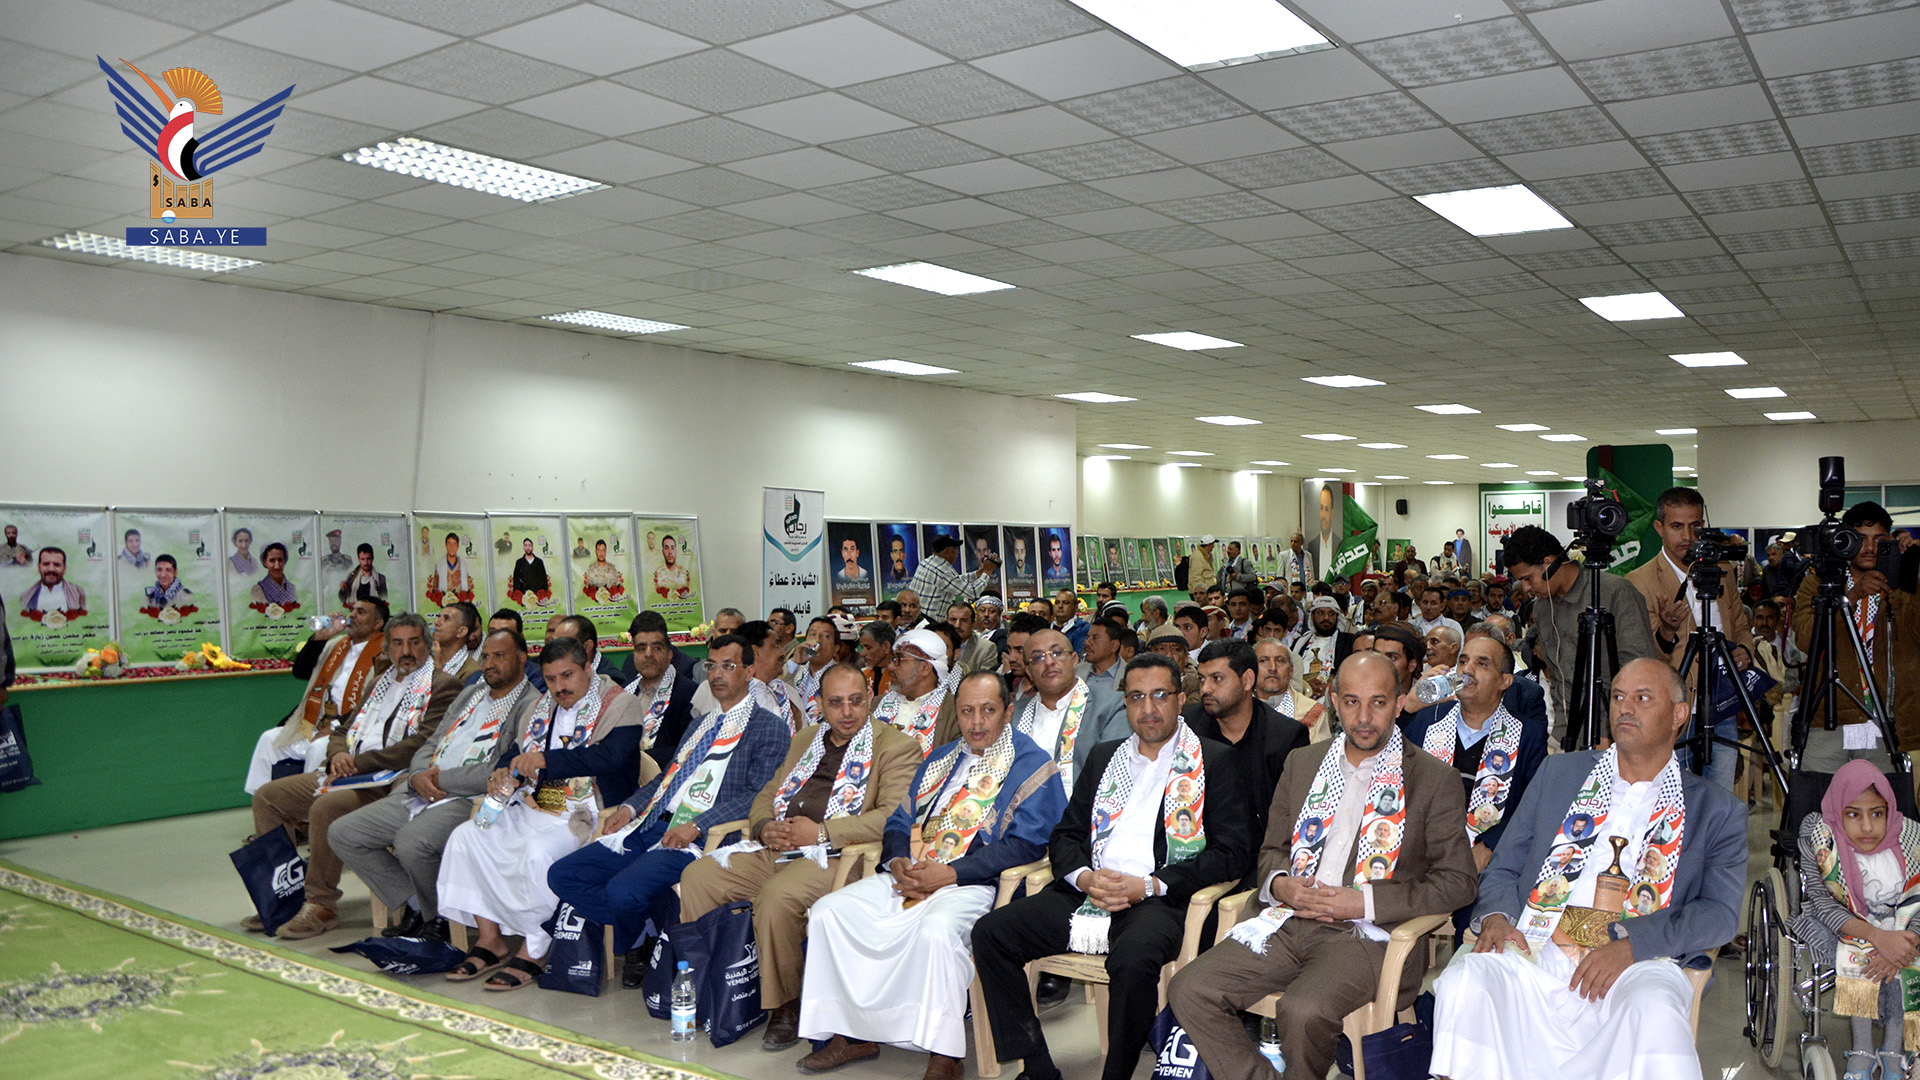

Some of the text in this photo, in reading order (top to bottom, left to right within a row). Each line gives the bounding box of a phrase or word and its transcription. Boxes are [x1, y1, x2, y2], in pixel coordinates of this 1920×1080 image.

[788, 521, 807, 535] رجال
[791, 571, 819, 589] الشهادة
[692, 790, 715, 804] رجال
[1578, 798, 1604, 810] رجال
[1312, 801, 1331, 812] رجال
[726, 976, 750, 987] YEMEN
[1158, 1065, 1194, 1079] YEMEN
